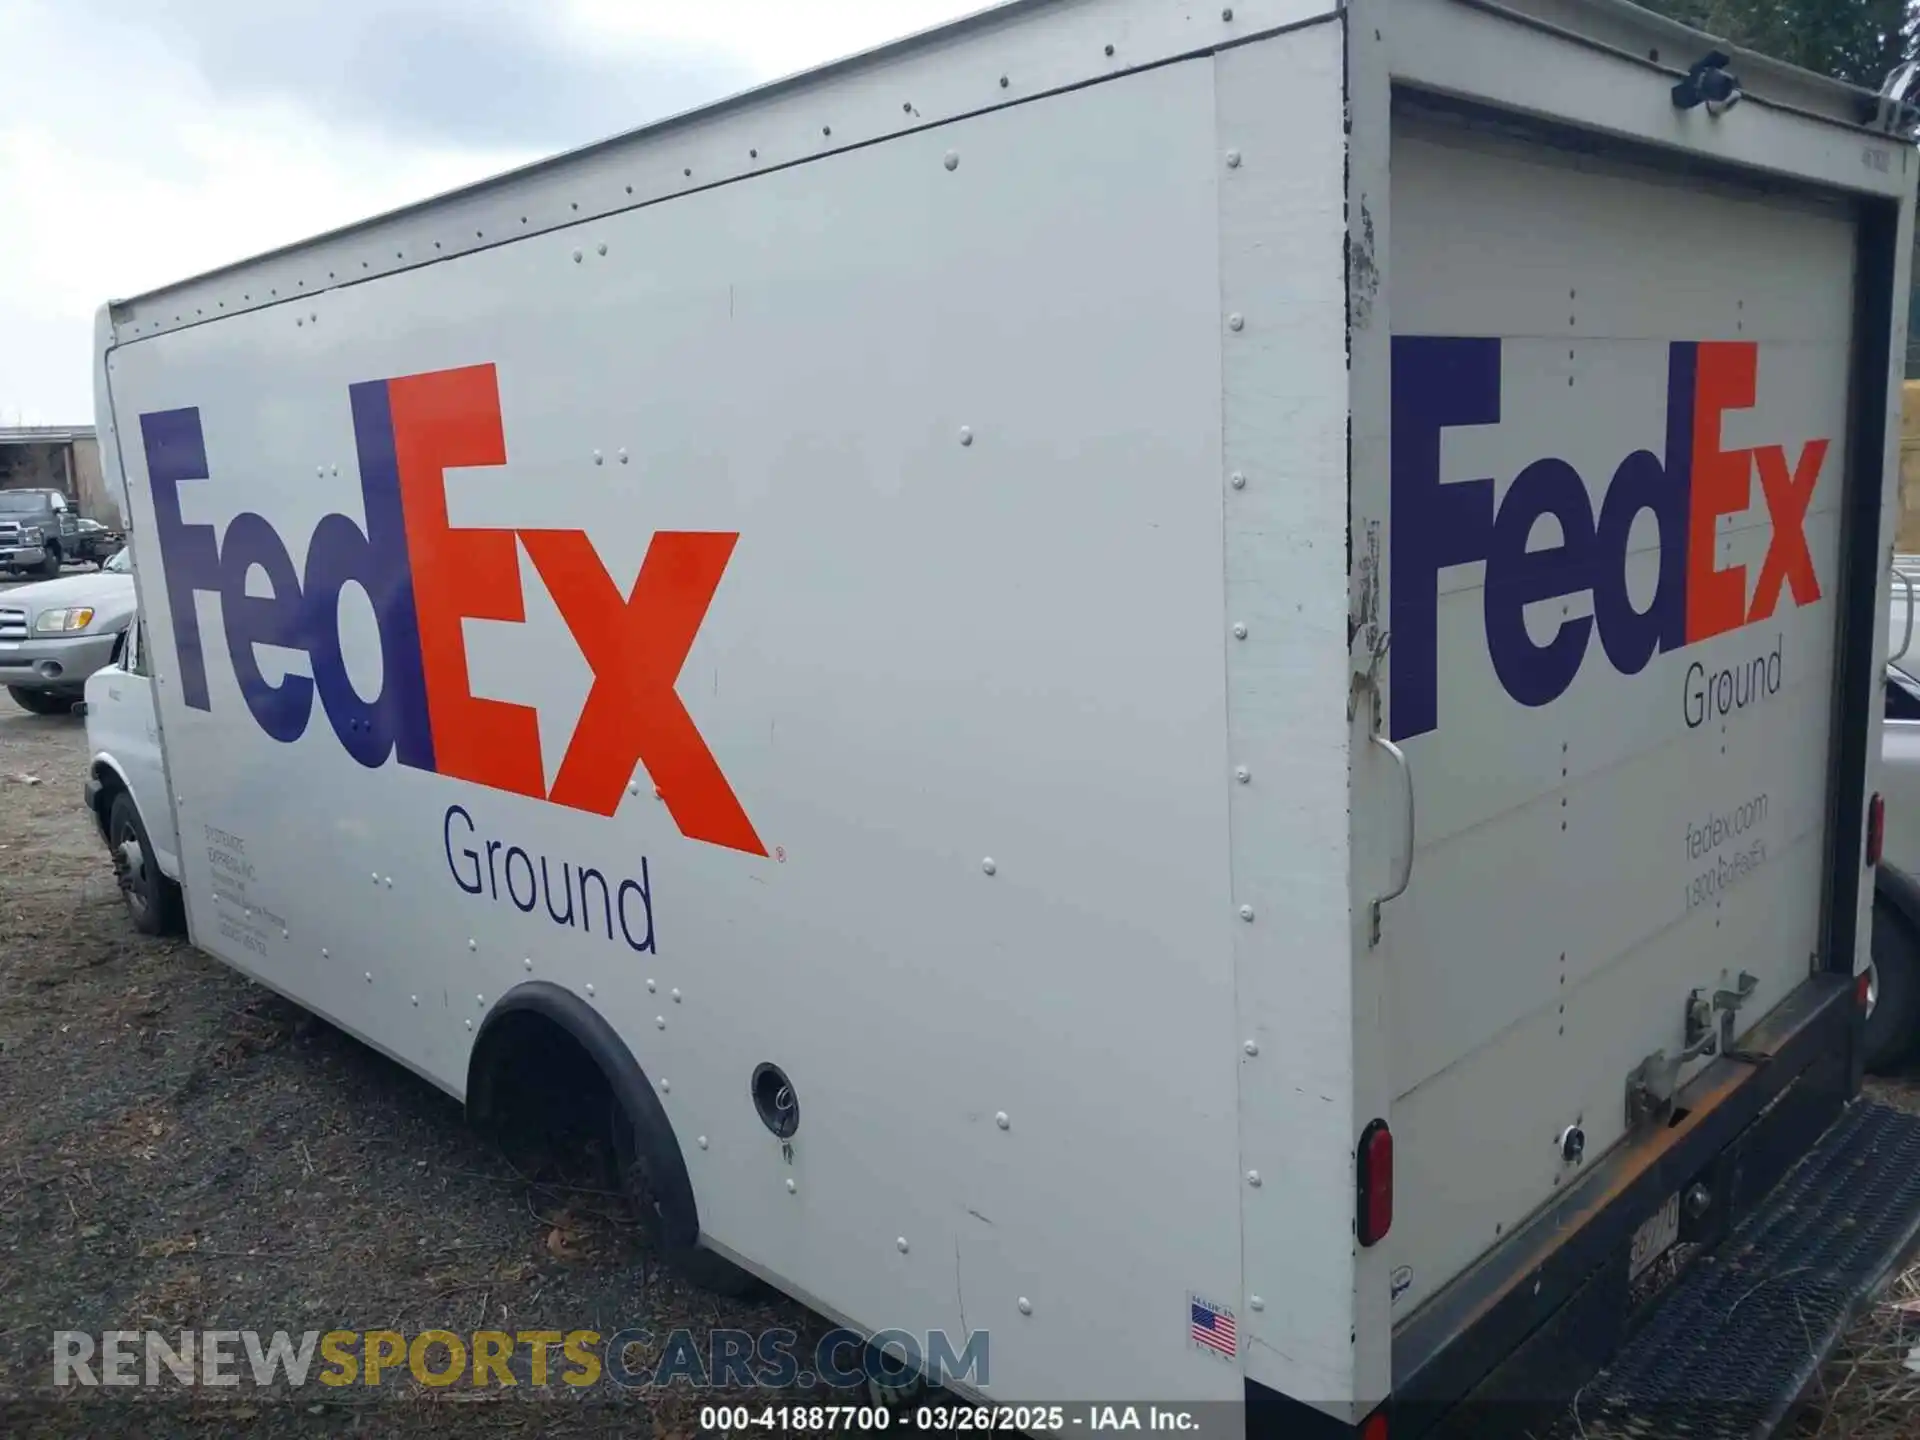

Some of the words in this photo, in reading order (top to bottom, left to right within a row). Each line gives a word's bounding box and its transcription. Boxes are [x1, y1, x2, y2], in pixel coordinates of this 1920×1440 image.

[140, 363, 769, 858] FedEx
[1390, 335, 1829, 741] FedEx
[1684, 632, 1782, 728] Ground
[444, 805, 656, 955] Ground
[1685, 793, 1768, 862] fedex.com
